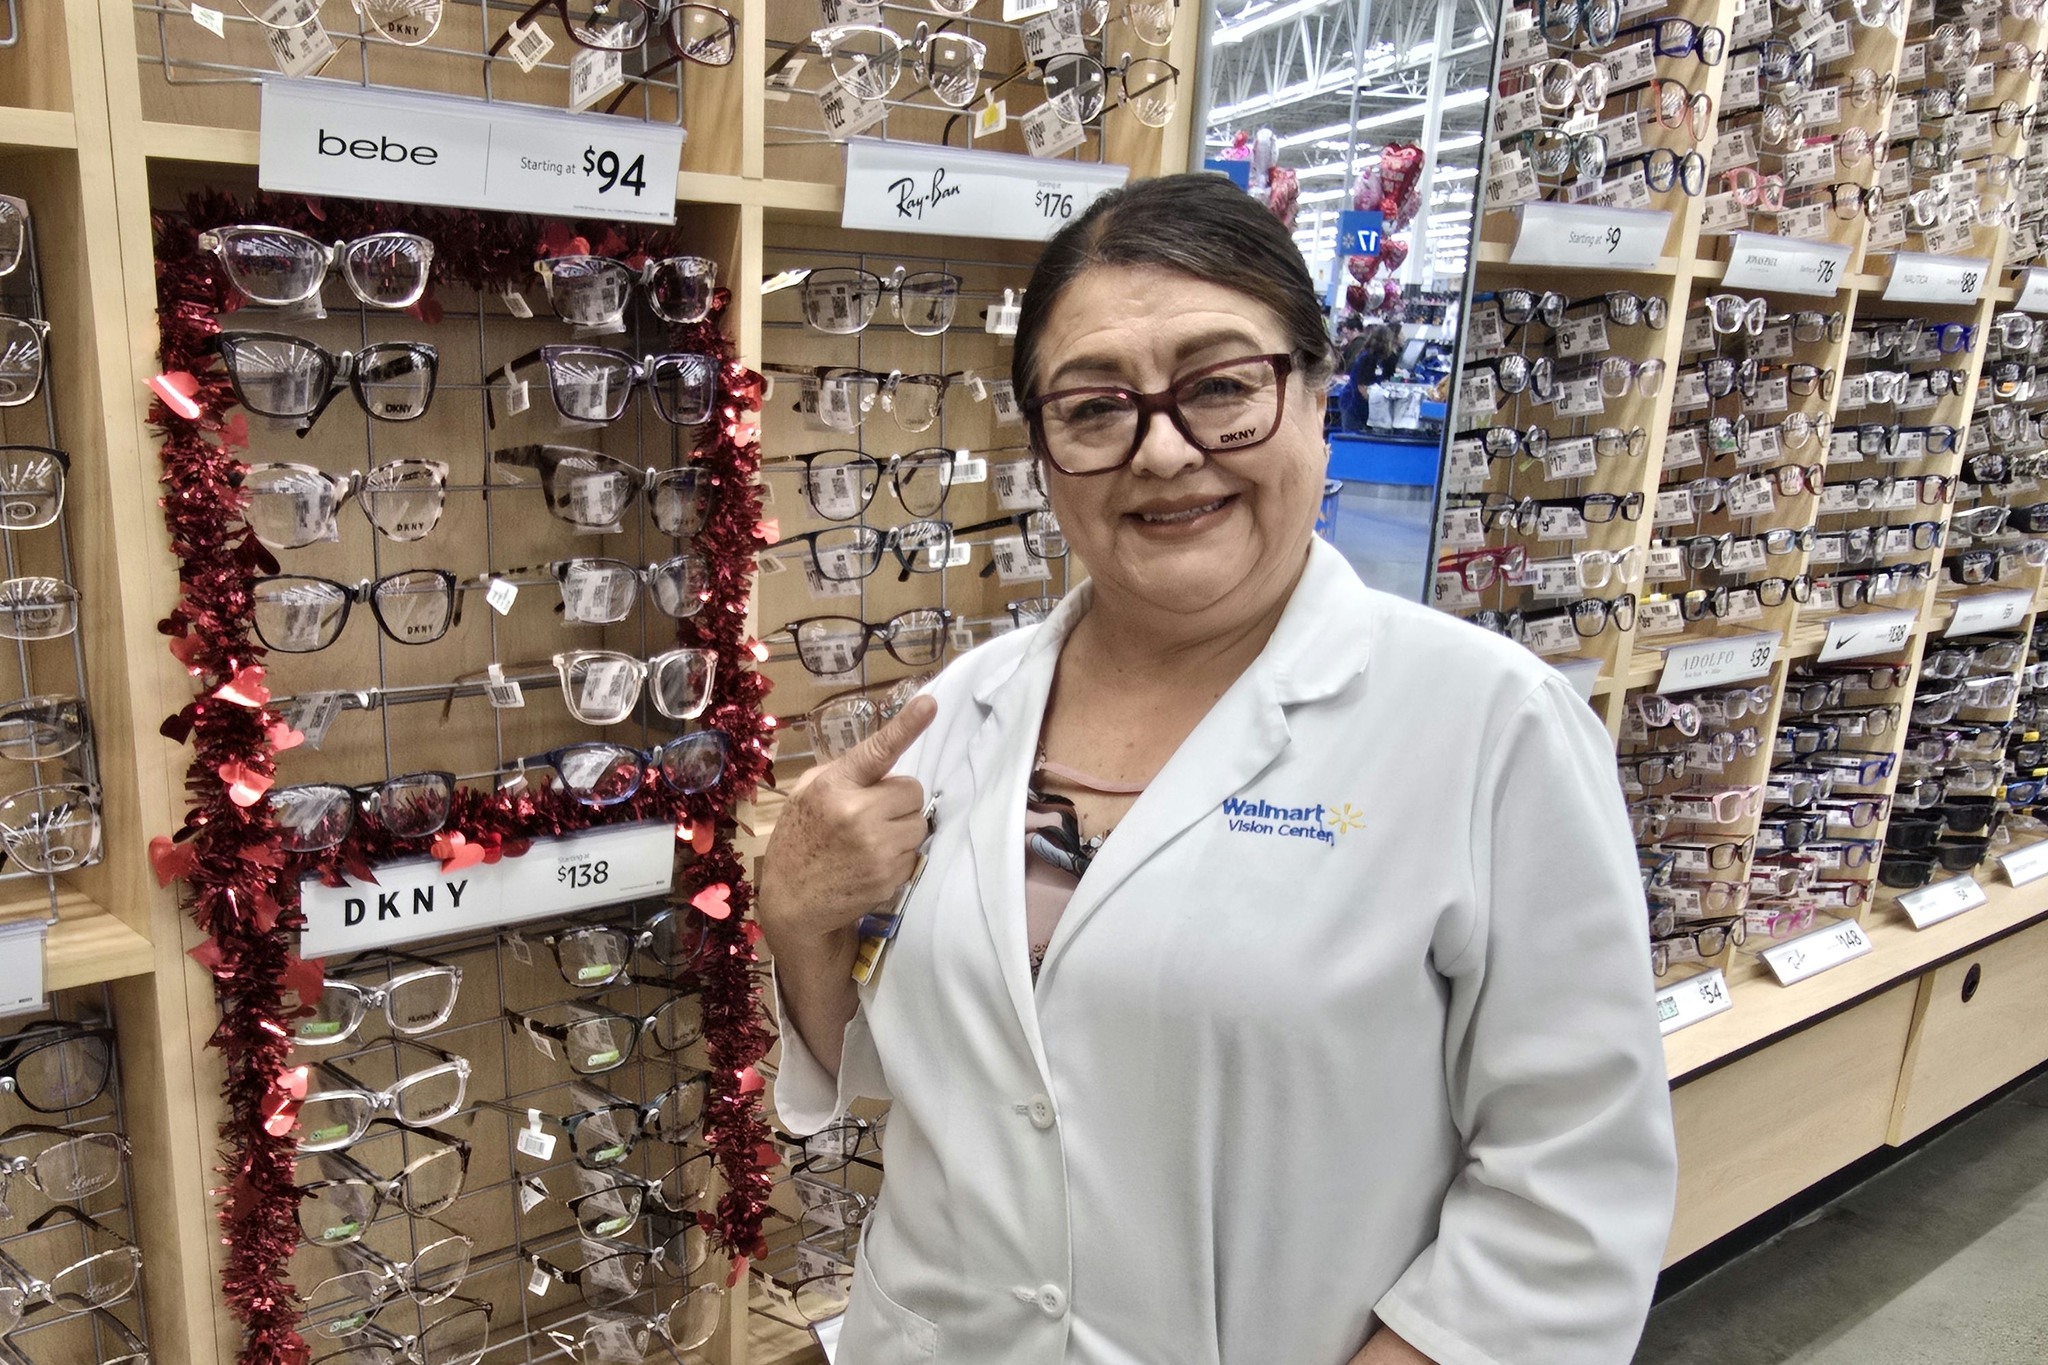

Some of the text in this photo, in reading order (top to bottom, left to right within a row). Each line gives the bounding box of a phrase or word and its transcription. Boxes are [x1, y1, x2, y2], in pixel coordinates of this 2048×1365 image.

[387, 21, 420, 37] DKNY
[317, 128, 439, 166] bebe
[520, 145, 647, 197] Starting at $94
[1035, 190, 1073, 219] $176
[1569, 231, 1595, 247] Starting
[1605, 226, 1622, 254] $9
[1817, 258, 1836, 283] $76
[385, 404, 412, 413] DKNY
[1220, 427, 1256, 443] DKNY
[396, 521, 424, 532] DKNY
[407, 624, 433, 635] DKNY
[1681, 650, 1735, 671] ADOLFO
[1750, 647, 1770, 667] $39
[1222, 797, 1325, 822] Walmart
[1229, 819, 1273, 835] Vision
[557, 861, 609, 889] $138
[344, 879, 469, 927] DKNY
[1835, 929, 1862, 949] $148
[1700, 981, 1722, 1004] $54
